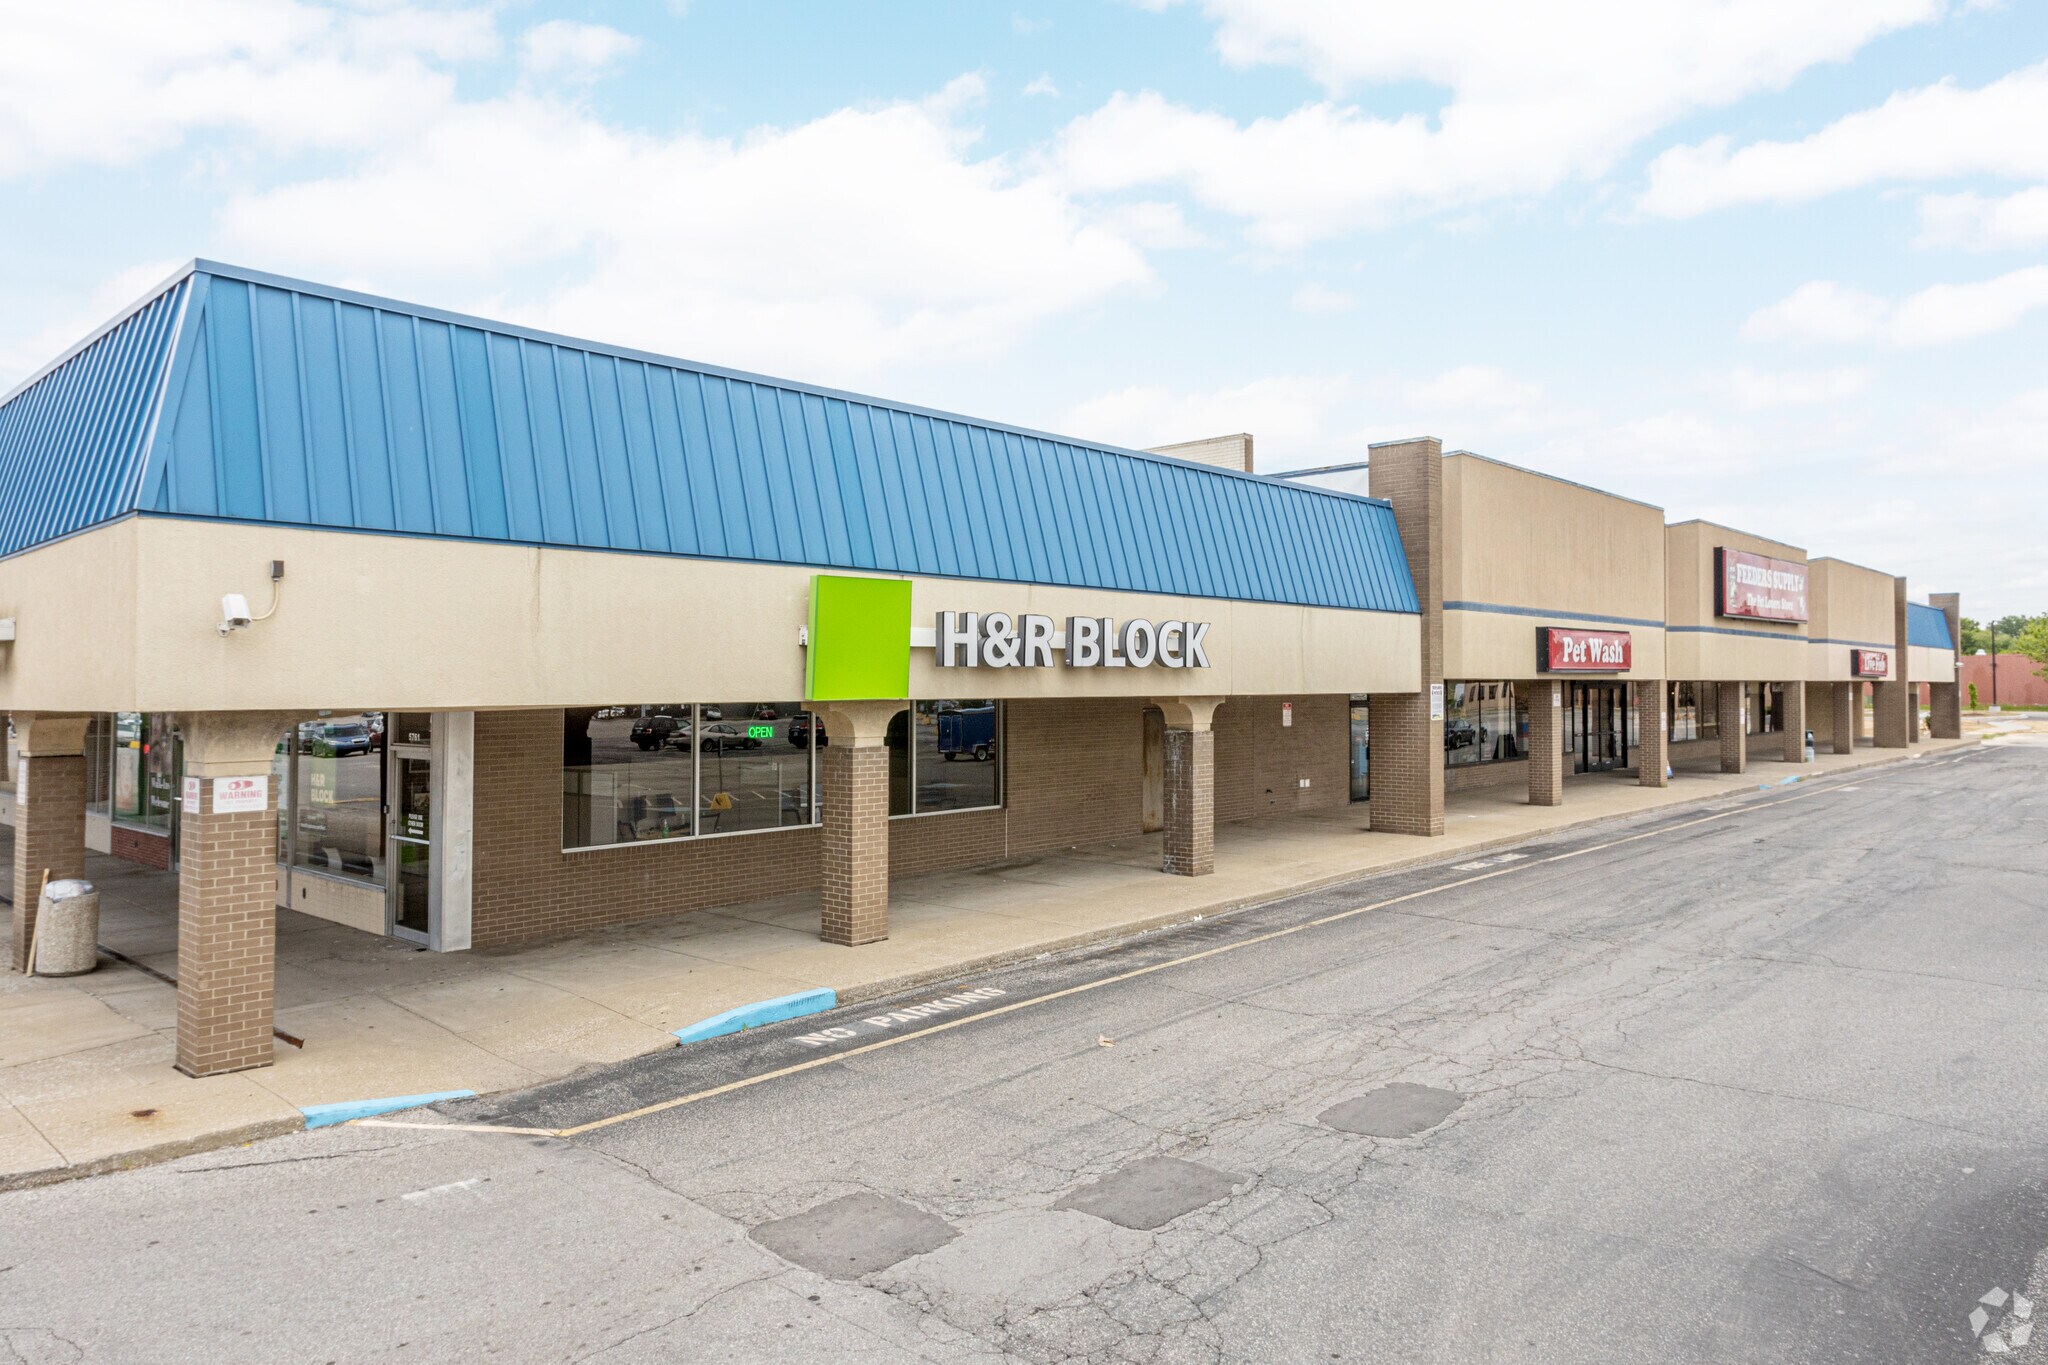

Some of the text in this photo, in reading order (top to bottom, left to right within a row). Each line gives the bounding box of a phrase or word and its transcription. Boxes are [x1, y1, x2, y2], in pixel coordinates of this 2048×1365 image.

[1737, 563, 1799, 592] FEEDERS SUPPLY
[1747, 593, 1757, 607] The
[1765, 596, 1781, 609] Lovers
[1781, 598, 1793, 610] Store
[936, 610, 1211, 668] H&R BLOCK
[1562, 636, 1624, 663] Pet Wash
[748, 726, 773, 738] OPEN
[311, 773, 325, 787] H&R
[219, 790, 262, 800] WARNING
[311, 789, 334, 804] BLOCK
[792, 987, 1007, 1046] NO PARKING
